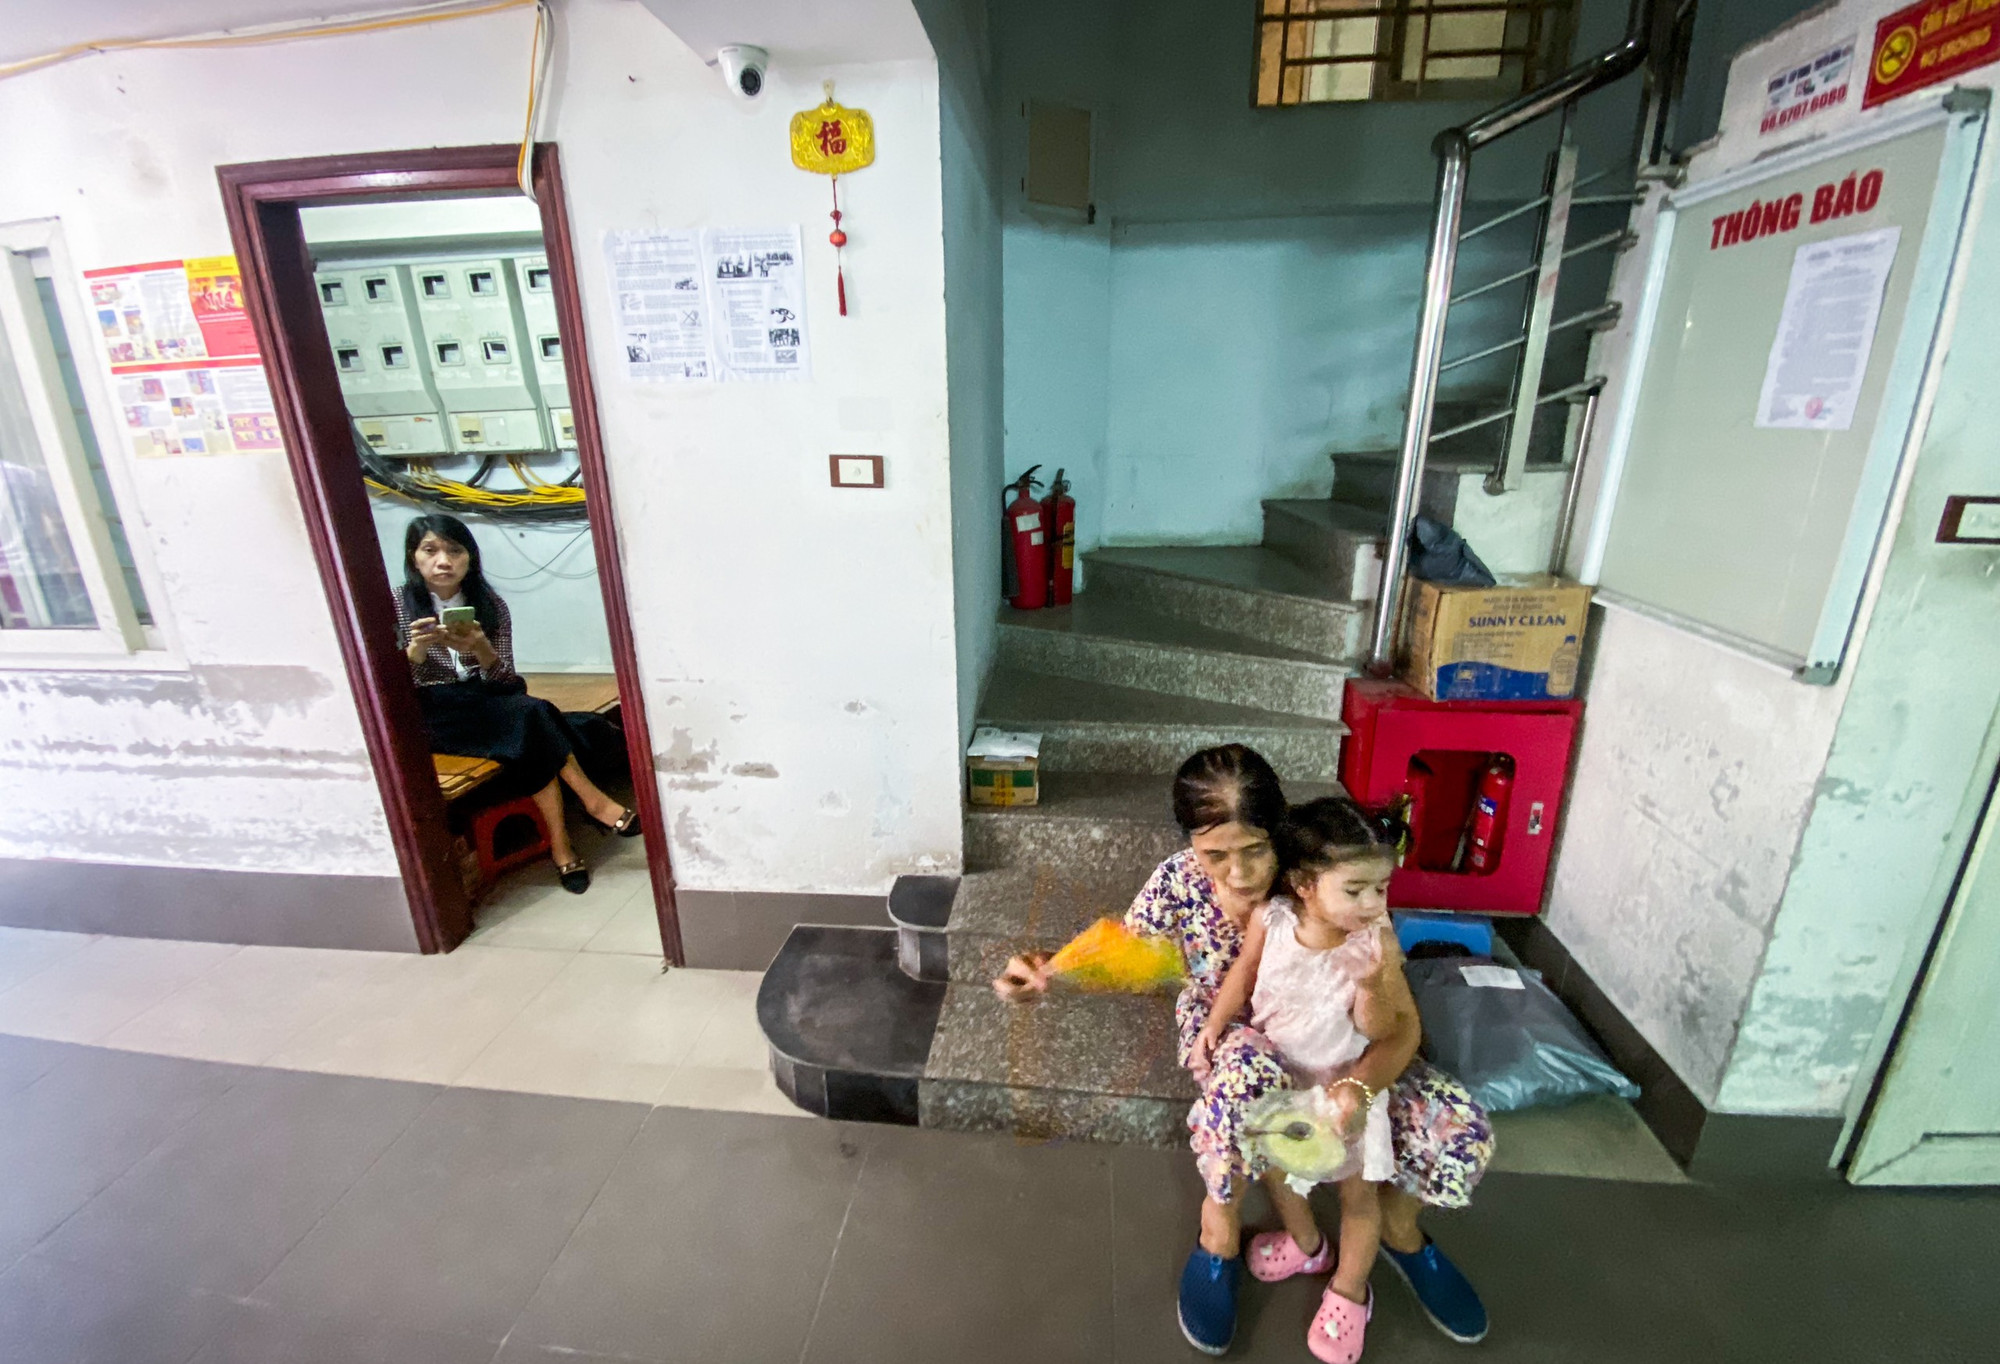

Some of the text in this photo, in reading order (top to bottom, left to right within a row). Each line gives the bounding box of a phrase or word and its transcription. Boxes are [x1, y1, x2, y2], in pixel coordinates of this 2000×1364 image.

[815, 119, 847, 157] 福
[1710, 193, 1803, 250] THÔNG
[1809, 168, 1883, 224] BÁO
[1468, 614, 1566, 628] SUNNY CLEAN
